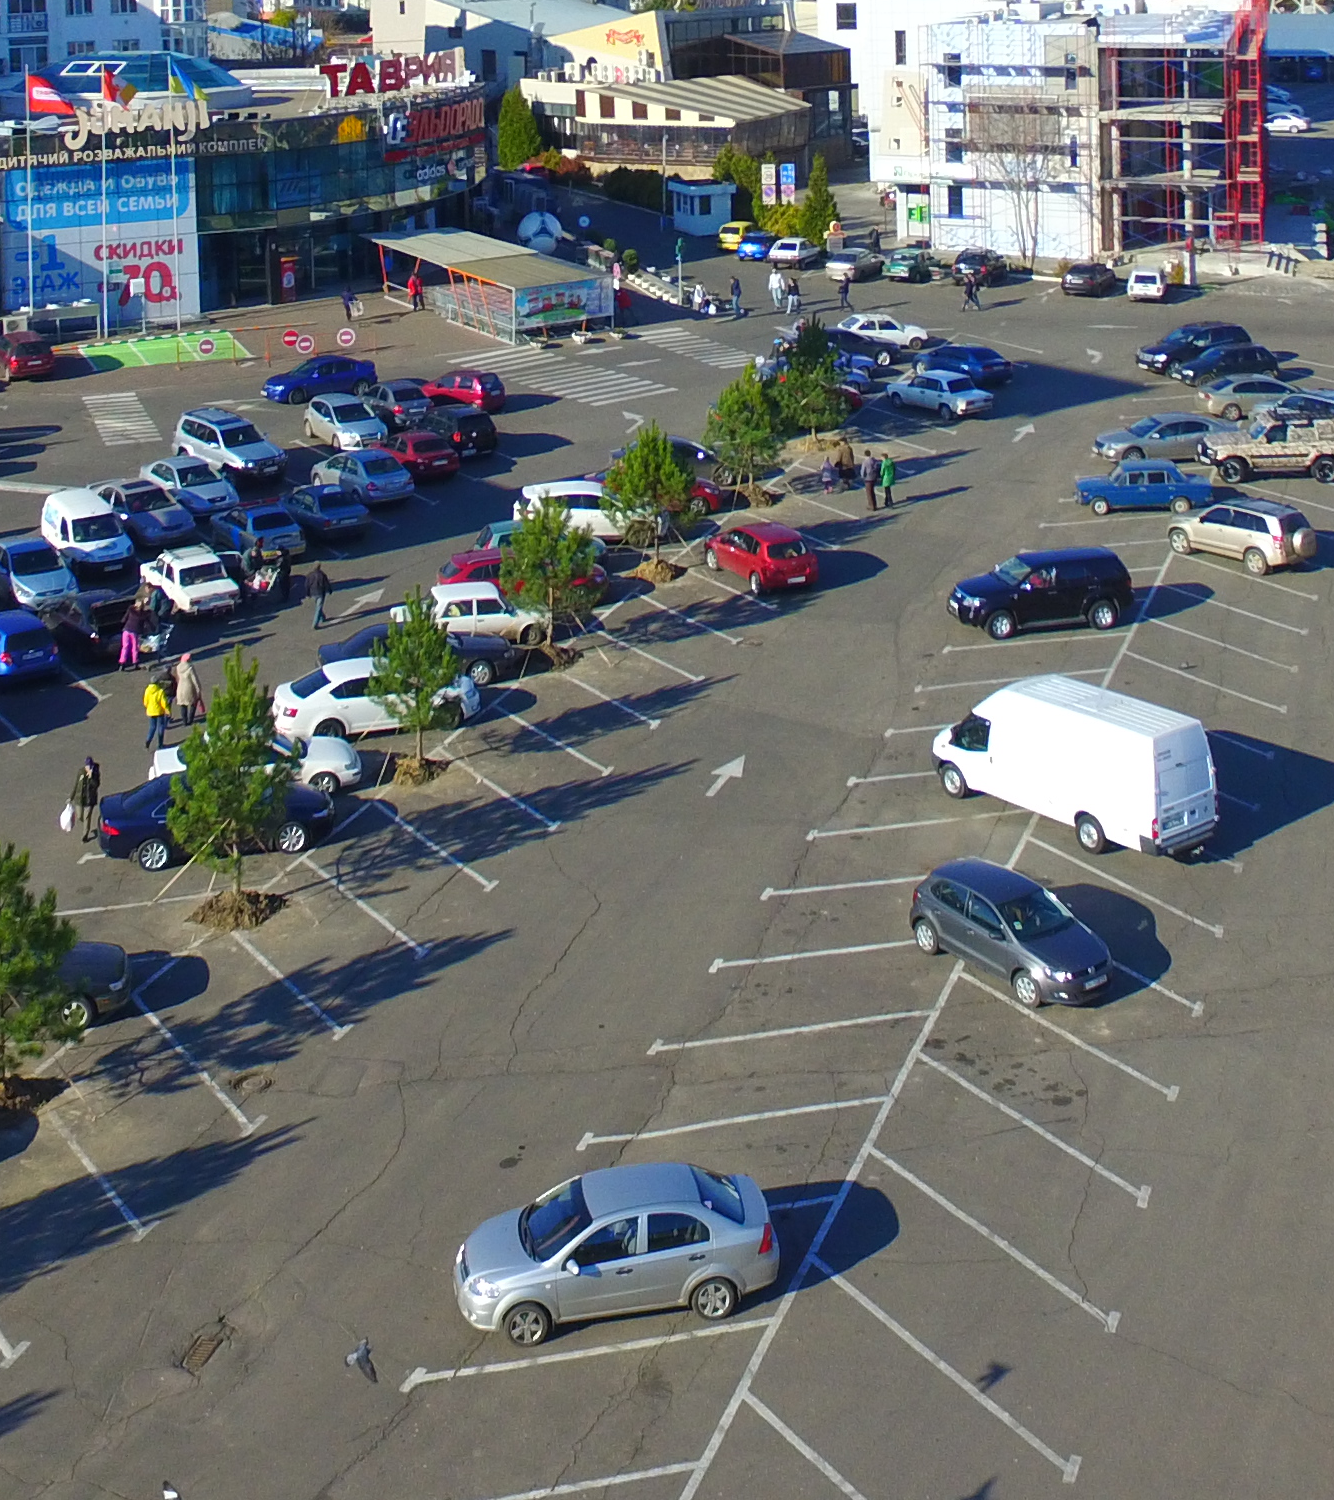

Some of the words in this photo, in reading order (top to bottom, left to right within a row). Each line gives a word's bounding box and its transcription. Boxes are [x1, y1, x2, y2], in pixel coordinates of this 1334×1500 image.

[16, 203, 57, 222] ДЛЯ
[63, 196, 109, 216] ВСЕЙ
[117, 193, 179, 212] СЕМЬИ
[93, 238, 184, 262] СКИДКИ
[12, 271, 81, 295] ЭТАЖ
